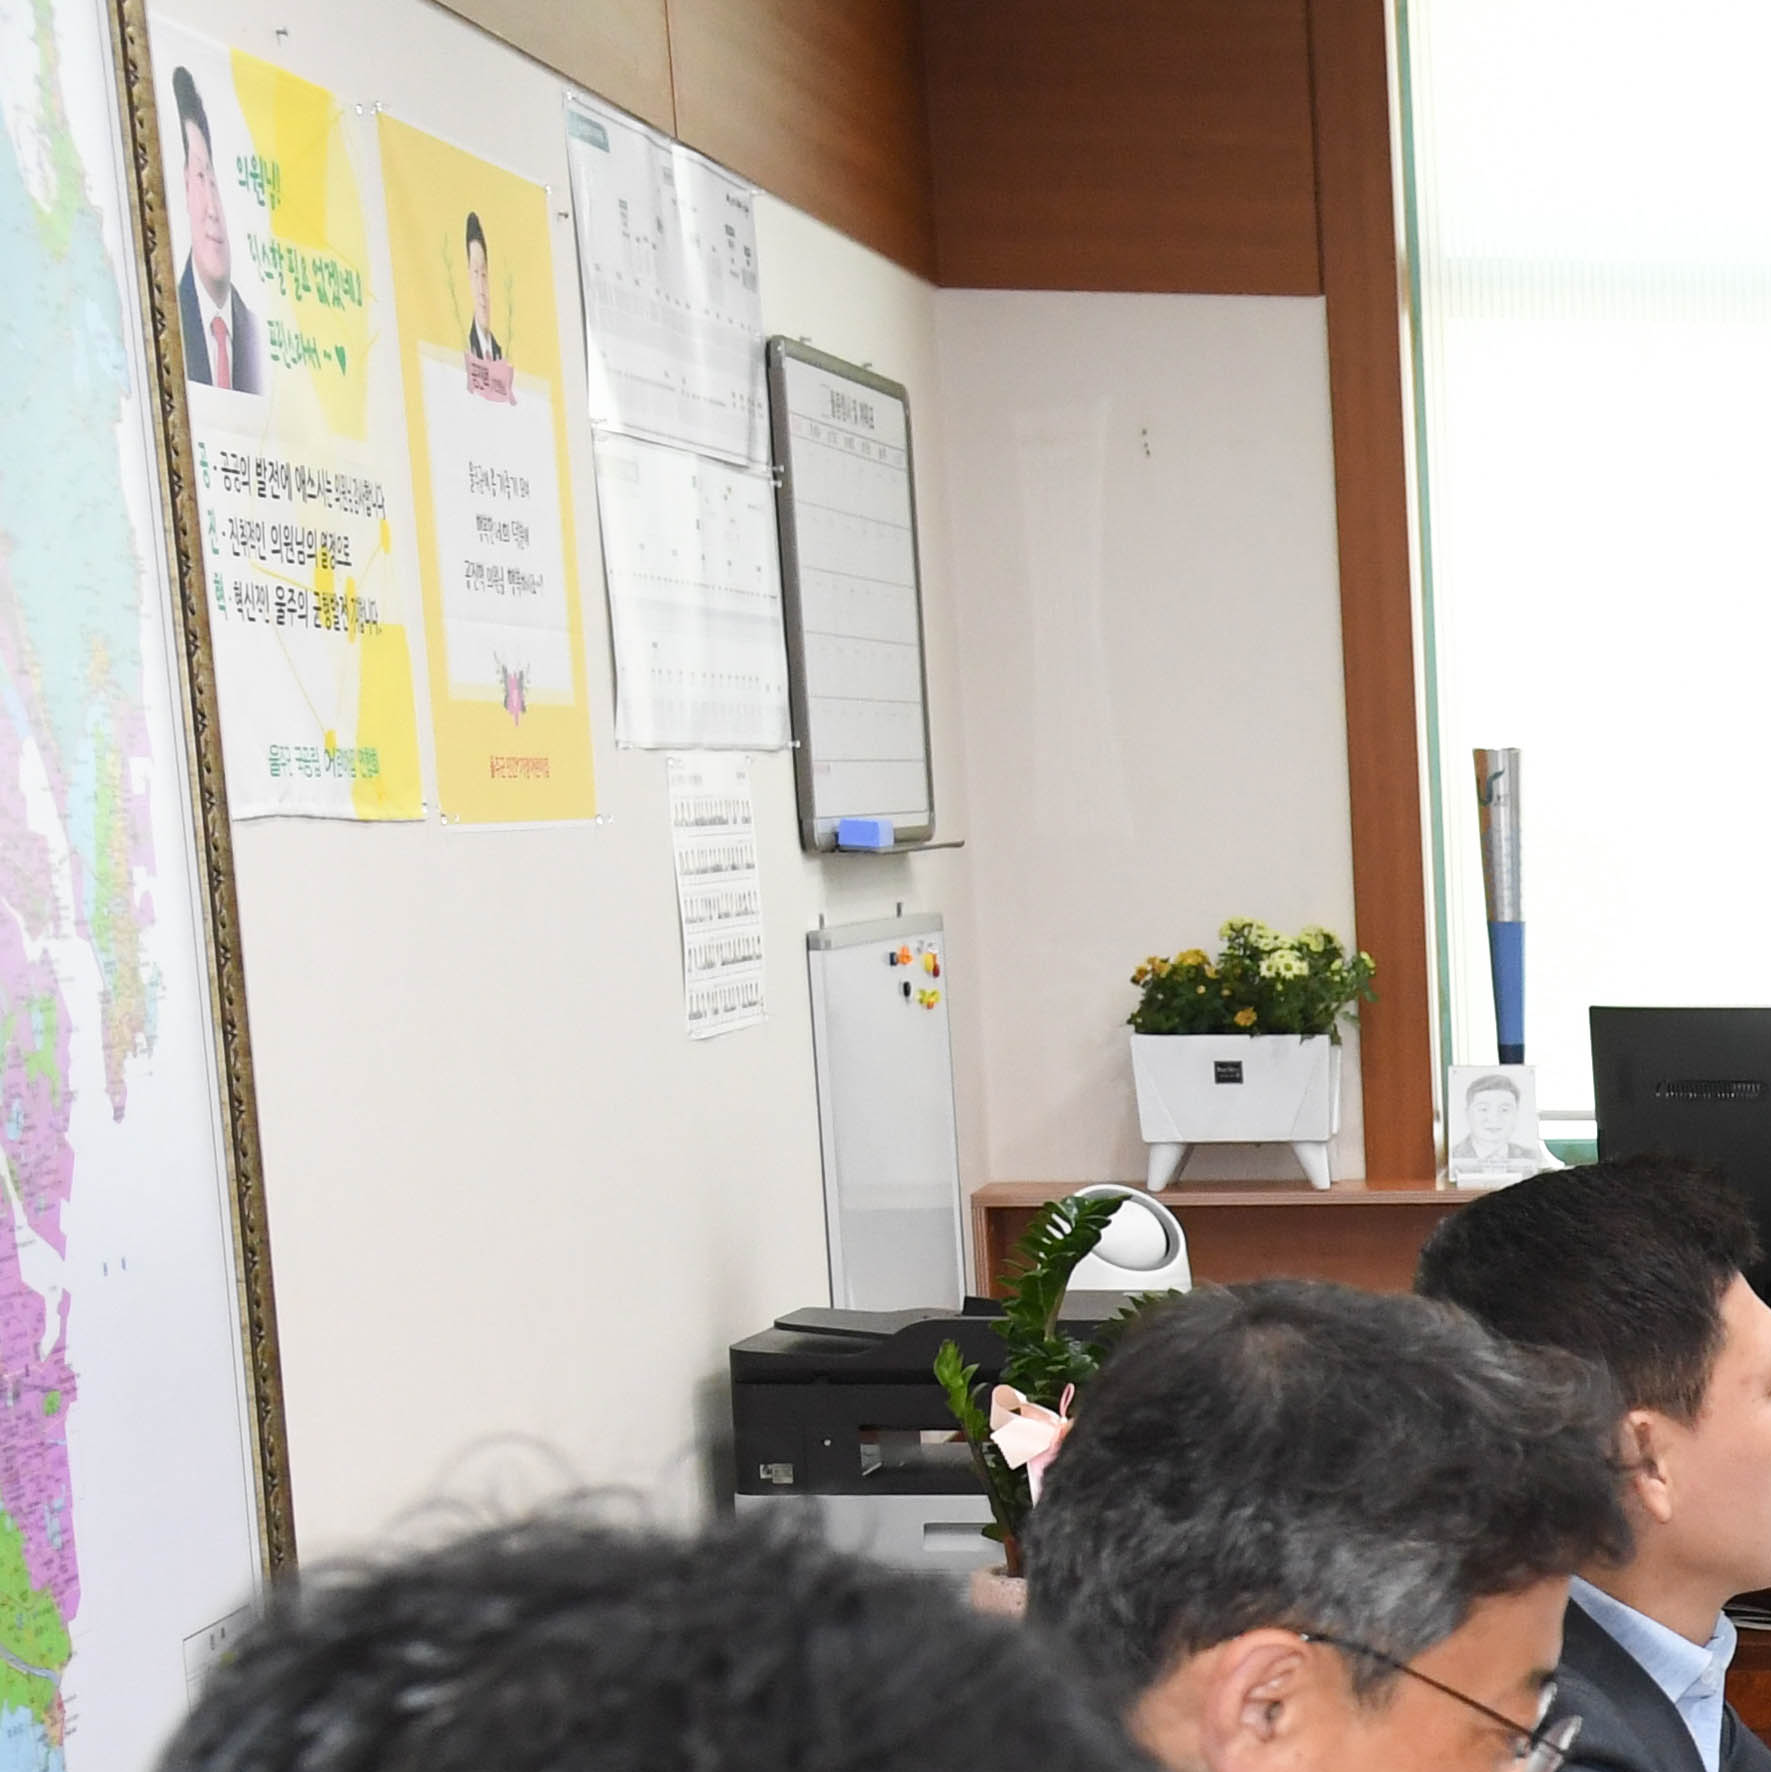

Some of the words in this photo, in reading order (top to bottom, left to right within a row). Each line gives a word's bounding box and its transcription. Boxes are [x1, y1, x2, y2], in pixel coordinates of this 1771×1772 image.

[221, 451, 251, 496] 공공의
[256, 456, 292, 501] 발전에
[271, 523, 318, 567] 의원님의
[275, 585, 309, 629] 울주의
